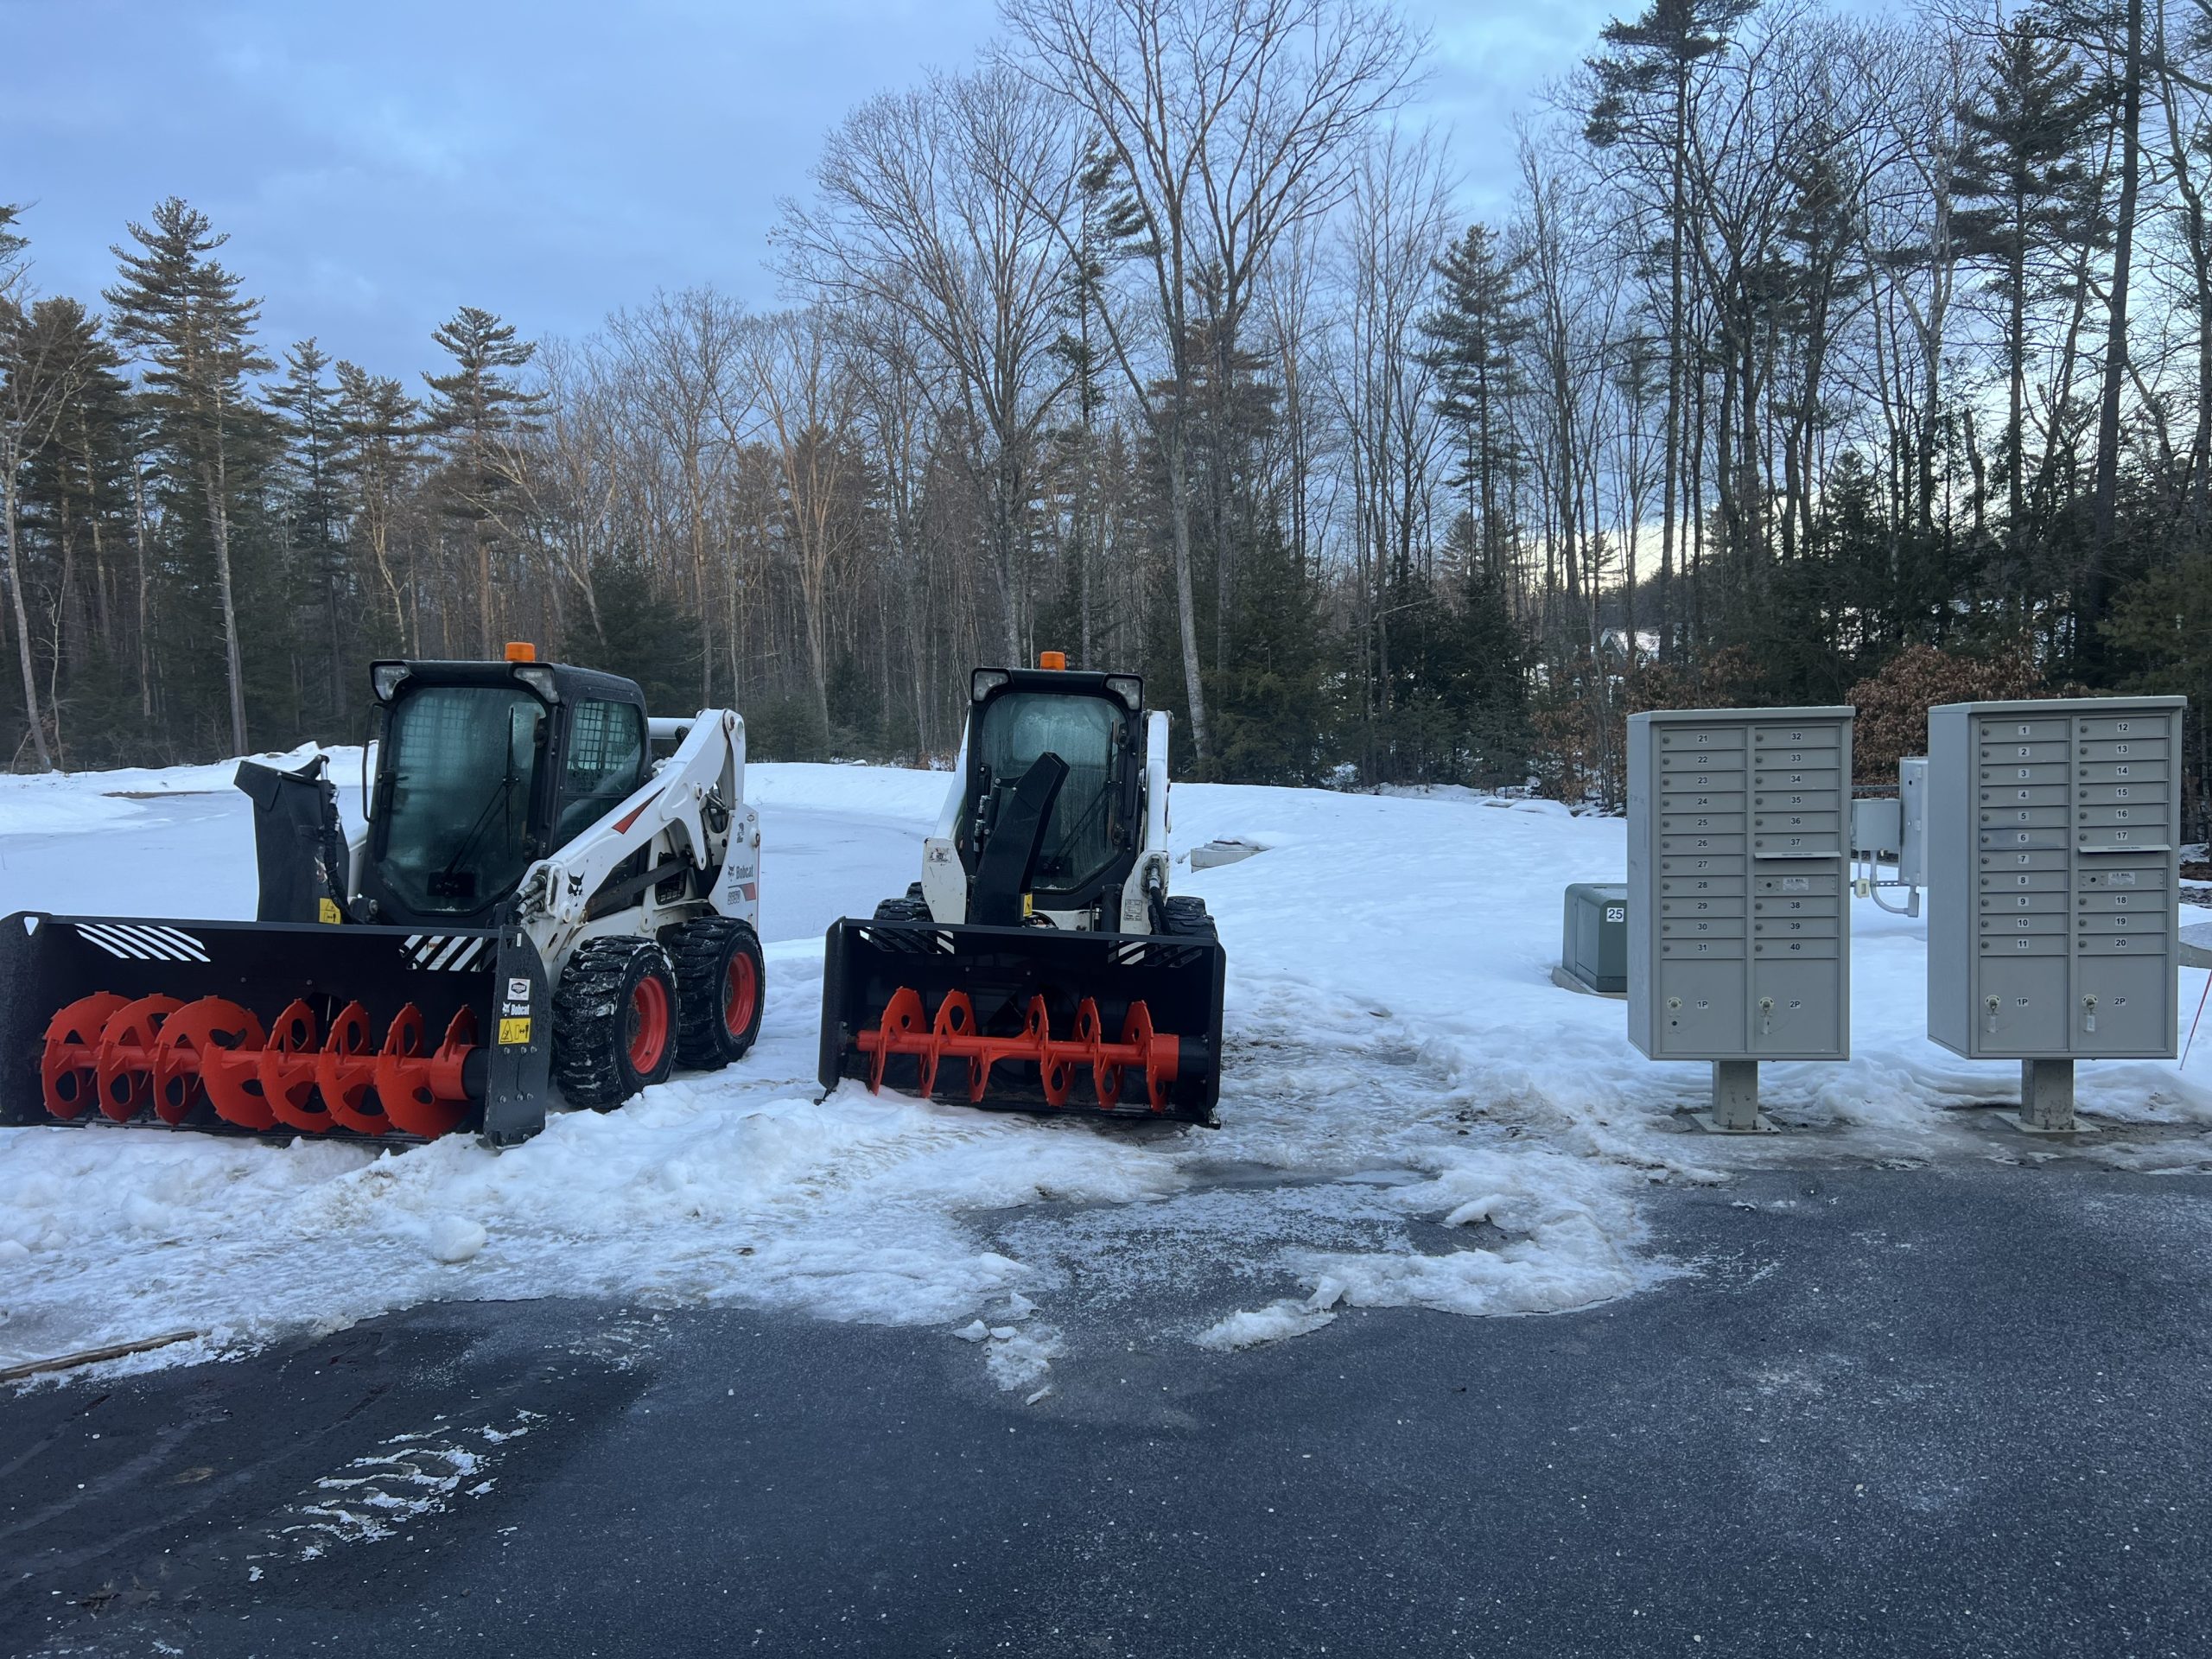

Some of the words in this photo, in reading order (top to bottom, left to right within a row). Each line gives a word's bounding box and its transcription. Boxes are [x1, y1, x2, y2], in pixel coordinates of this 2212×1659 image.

[1791, 753, 1802, 762] 33
[735, 865, 753, 880] Bobcat
[1607, 908, 1623, 919] 25
[510, 1003, 530, 1016] Bobcat
